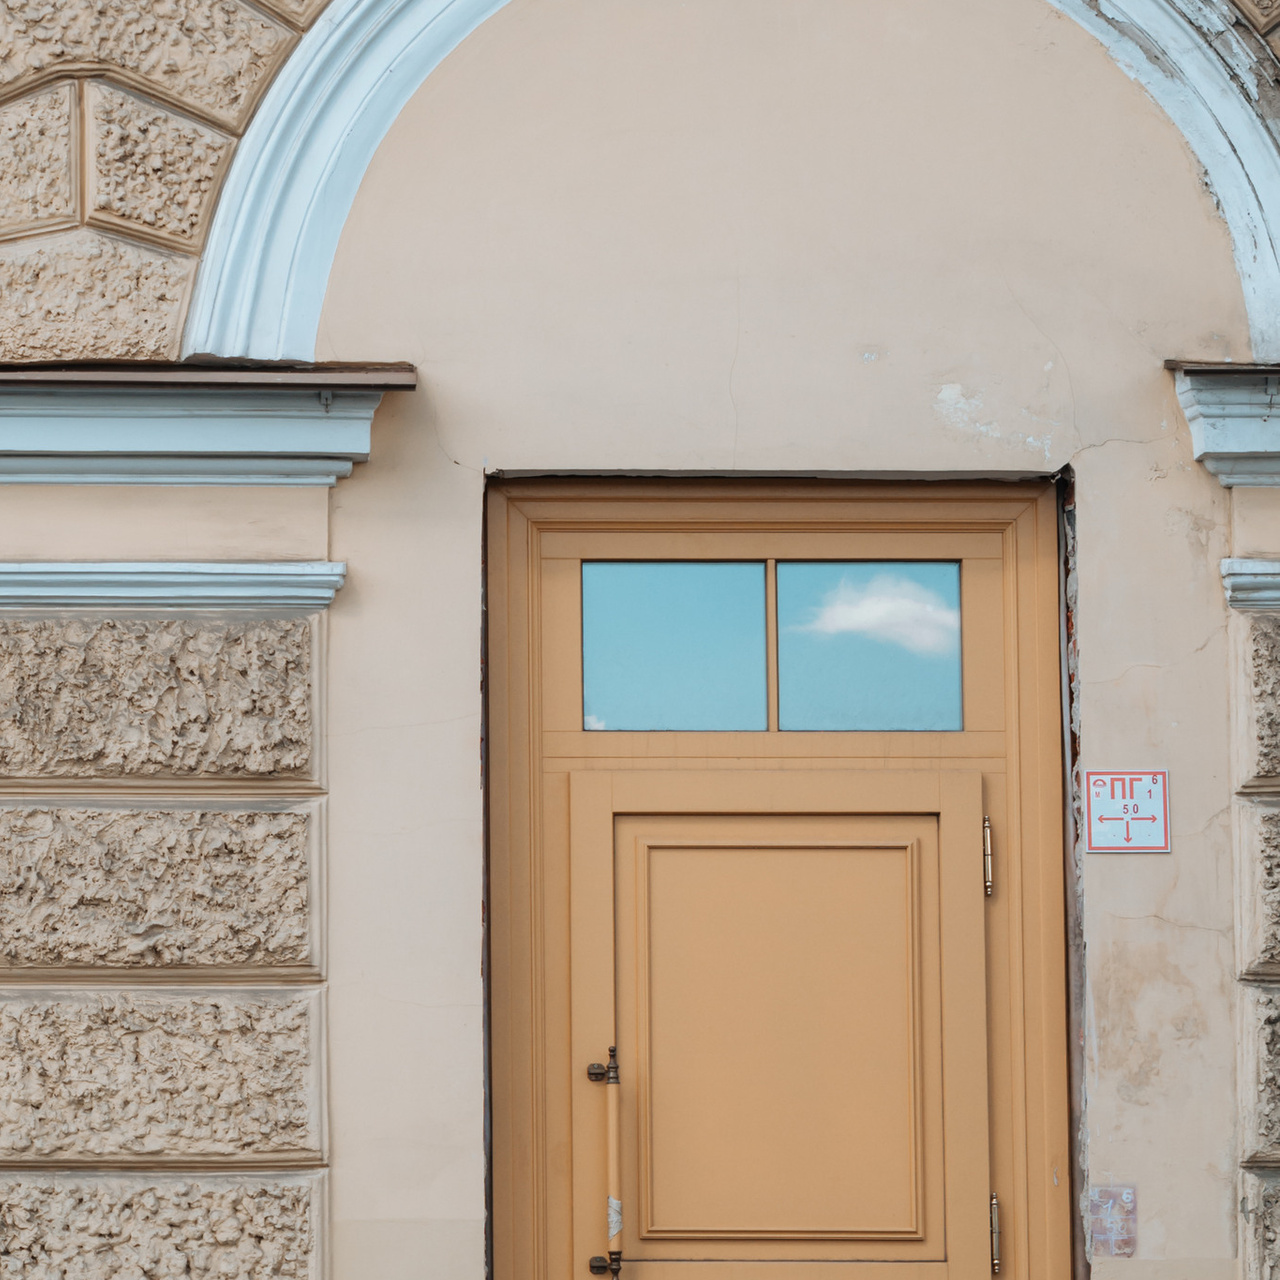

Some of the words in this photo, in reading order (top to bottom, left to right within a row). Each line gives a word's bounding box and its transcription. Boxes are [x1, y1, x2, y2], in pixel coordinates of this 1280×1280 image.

[1151, 774, 1158, 784] 6
[1110, 777, 1142, 799] ПГ
[1147, 789, 1152, 799] 1
